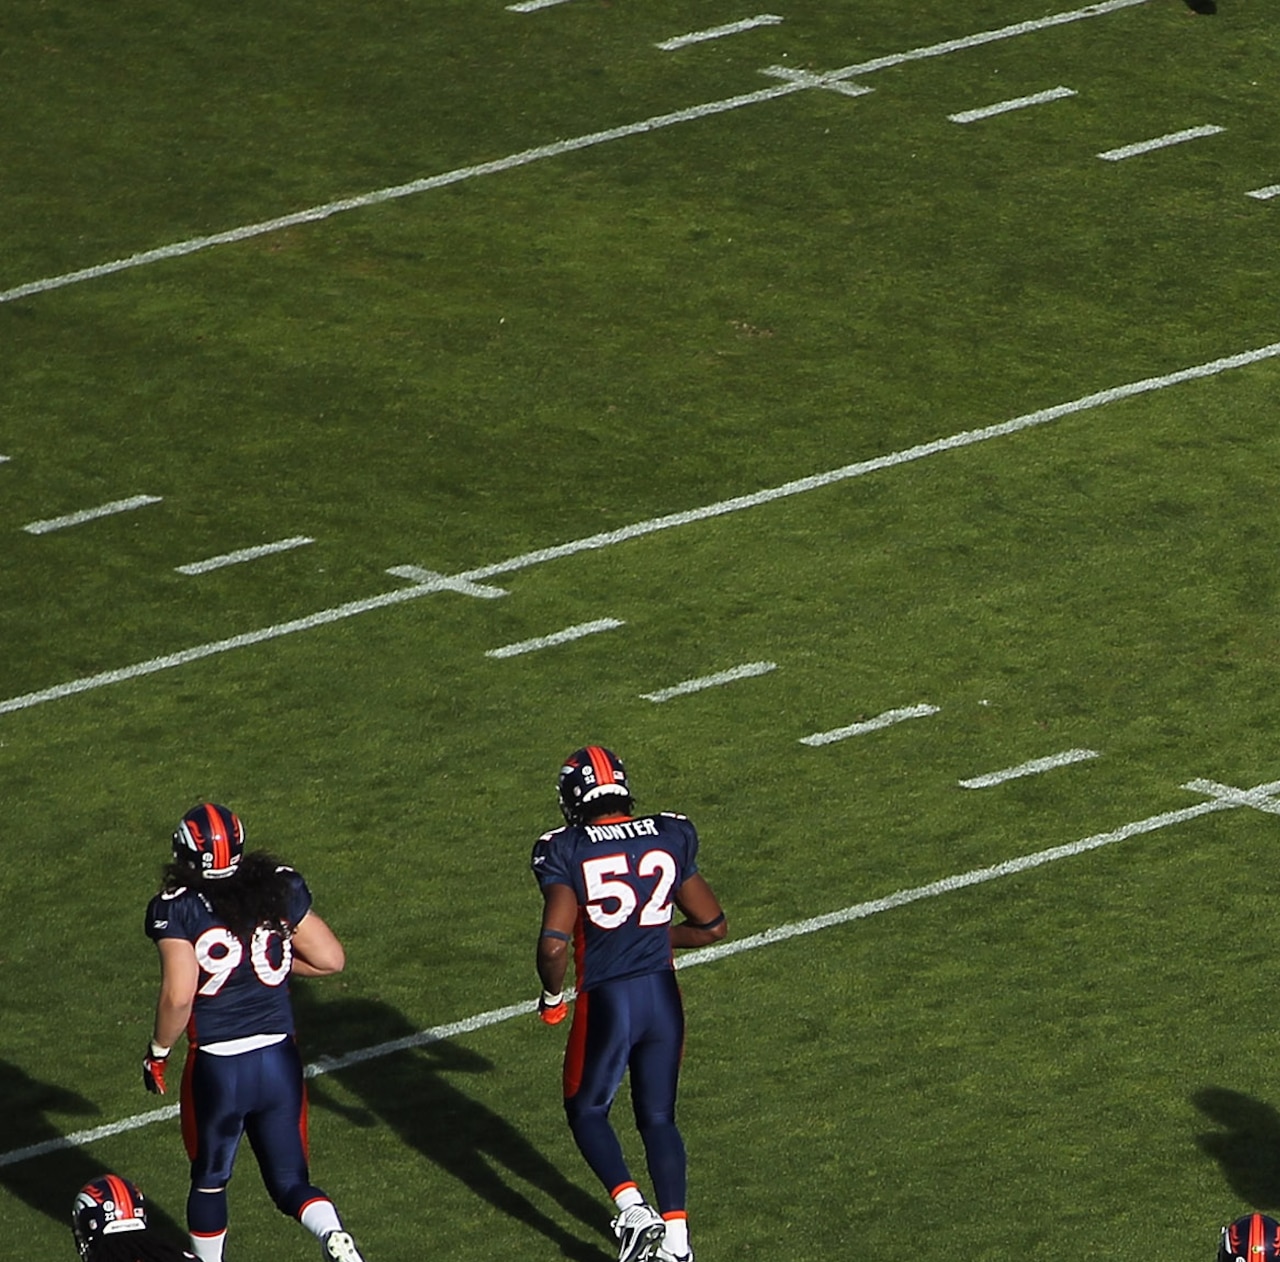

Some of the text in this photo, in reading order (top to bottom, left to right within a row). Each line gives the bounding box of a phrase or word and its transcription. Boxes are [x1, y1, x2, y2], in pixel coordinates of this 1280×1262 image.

[584, 817, 659, 845] HUNTER
[580, 848, 678, 931] 52
[193, 920, 294, 998] 90
